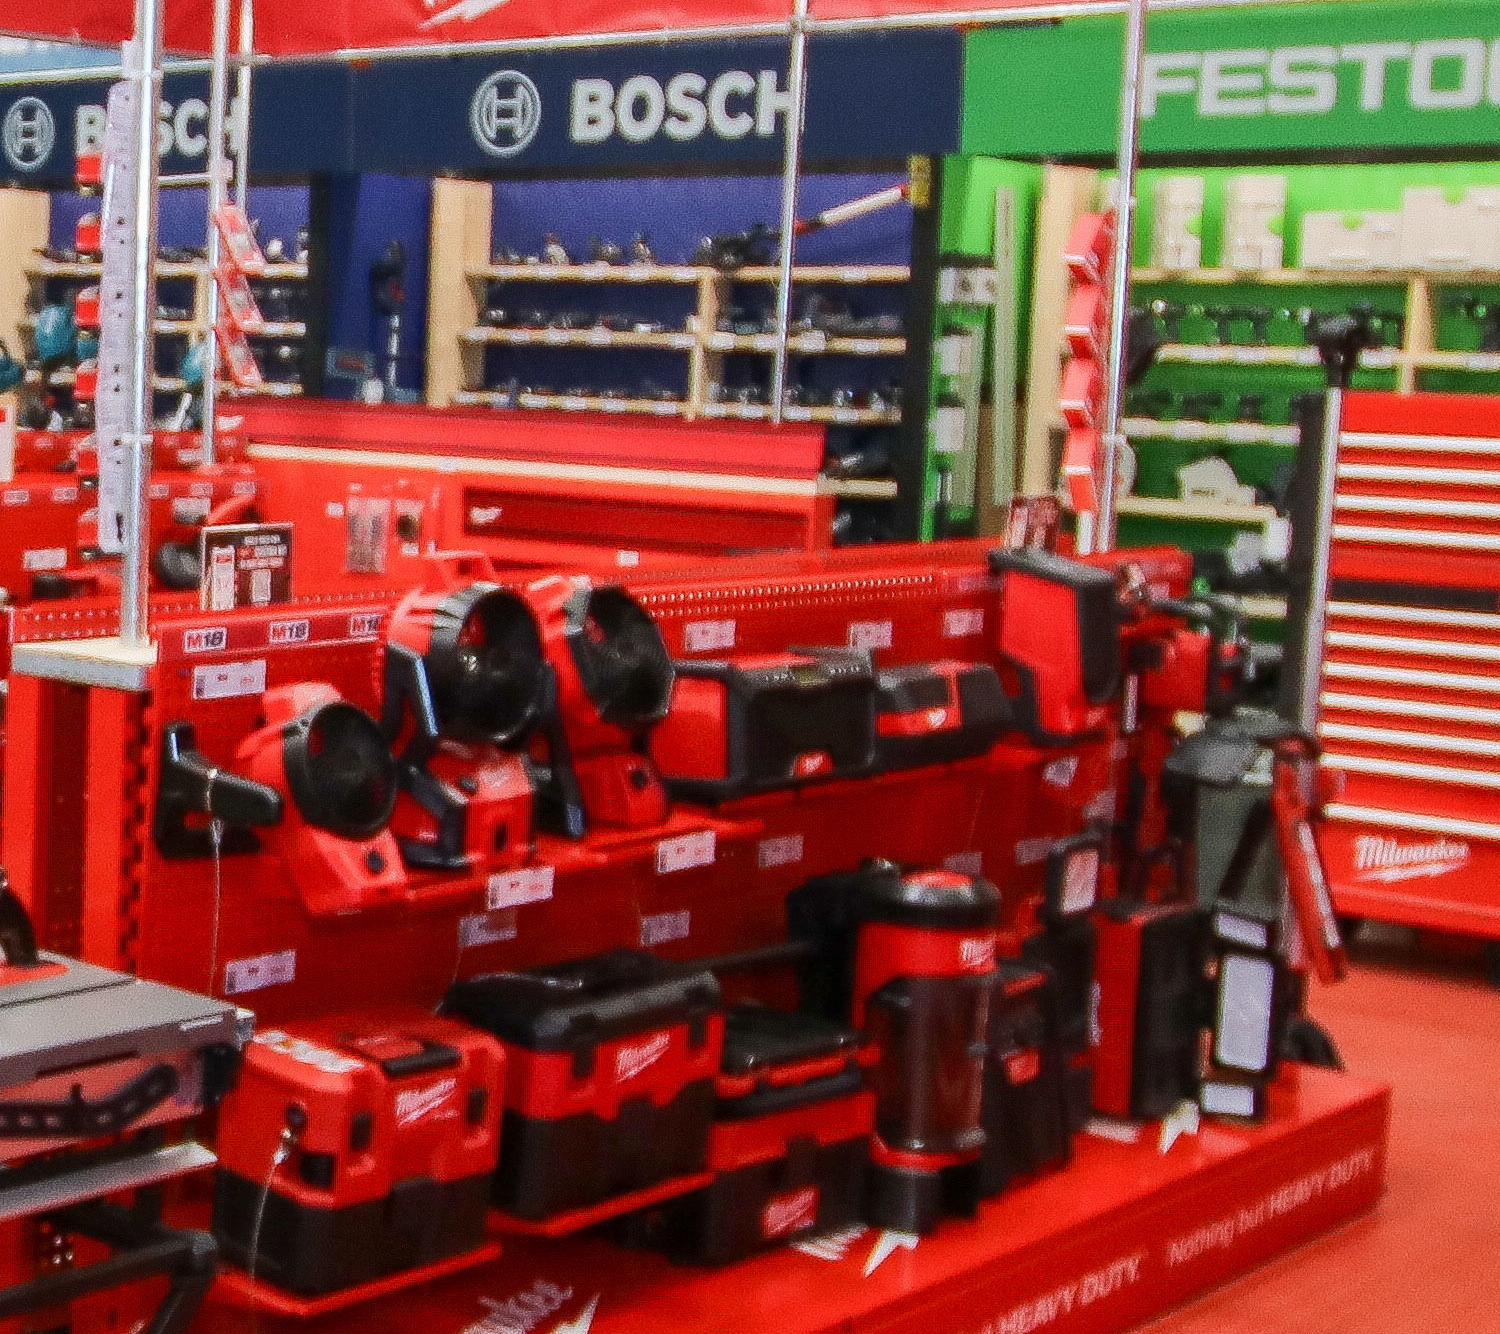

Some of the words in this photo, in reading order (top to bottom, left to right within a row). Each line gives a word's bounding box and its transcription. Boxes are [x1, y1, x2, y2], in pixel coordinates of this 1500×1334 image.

[569, 67, 797, 146] BOSCH
[186, 629, 225, 651] M18
[1268, 1166, 1326, 1217] HEAVY
